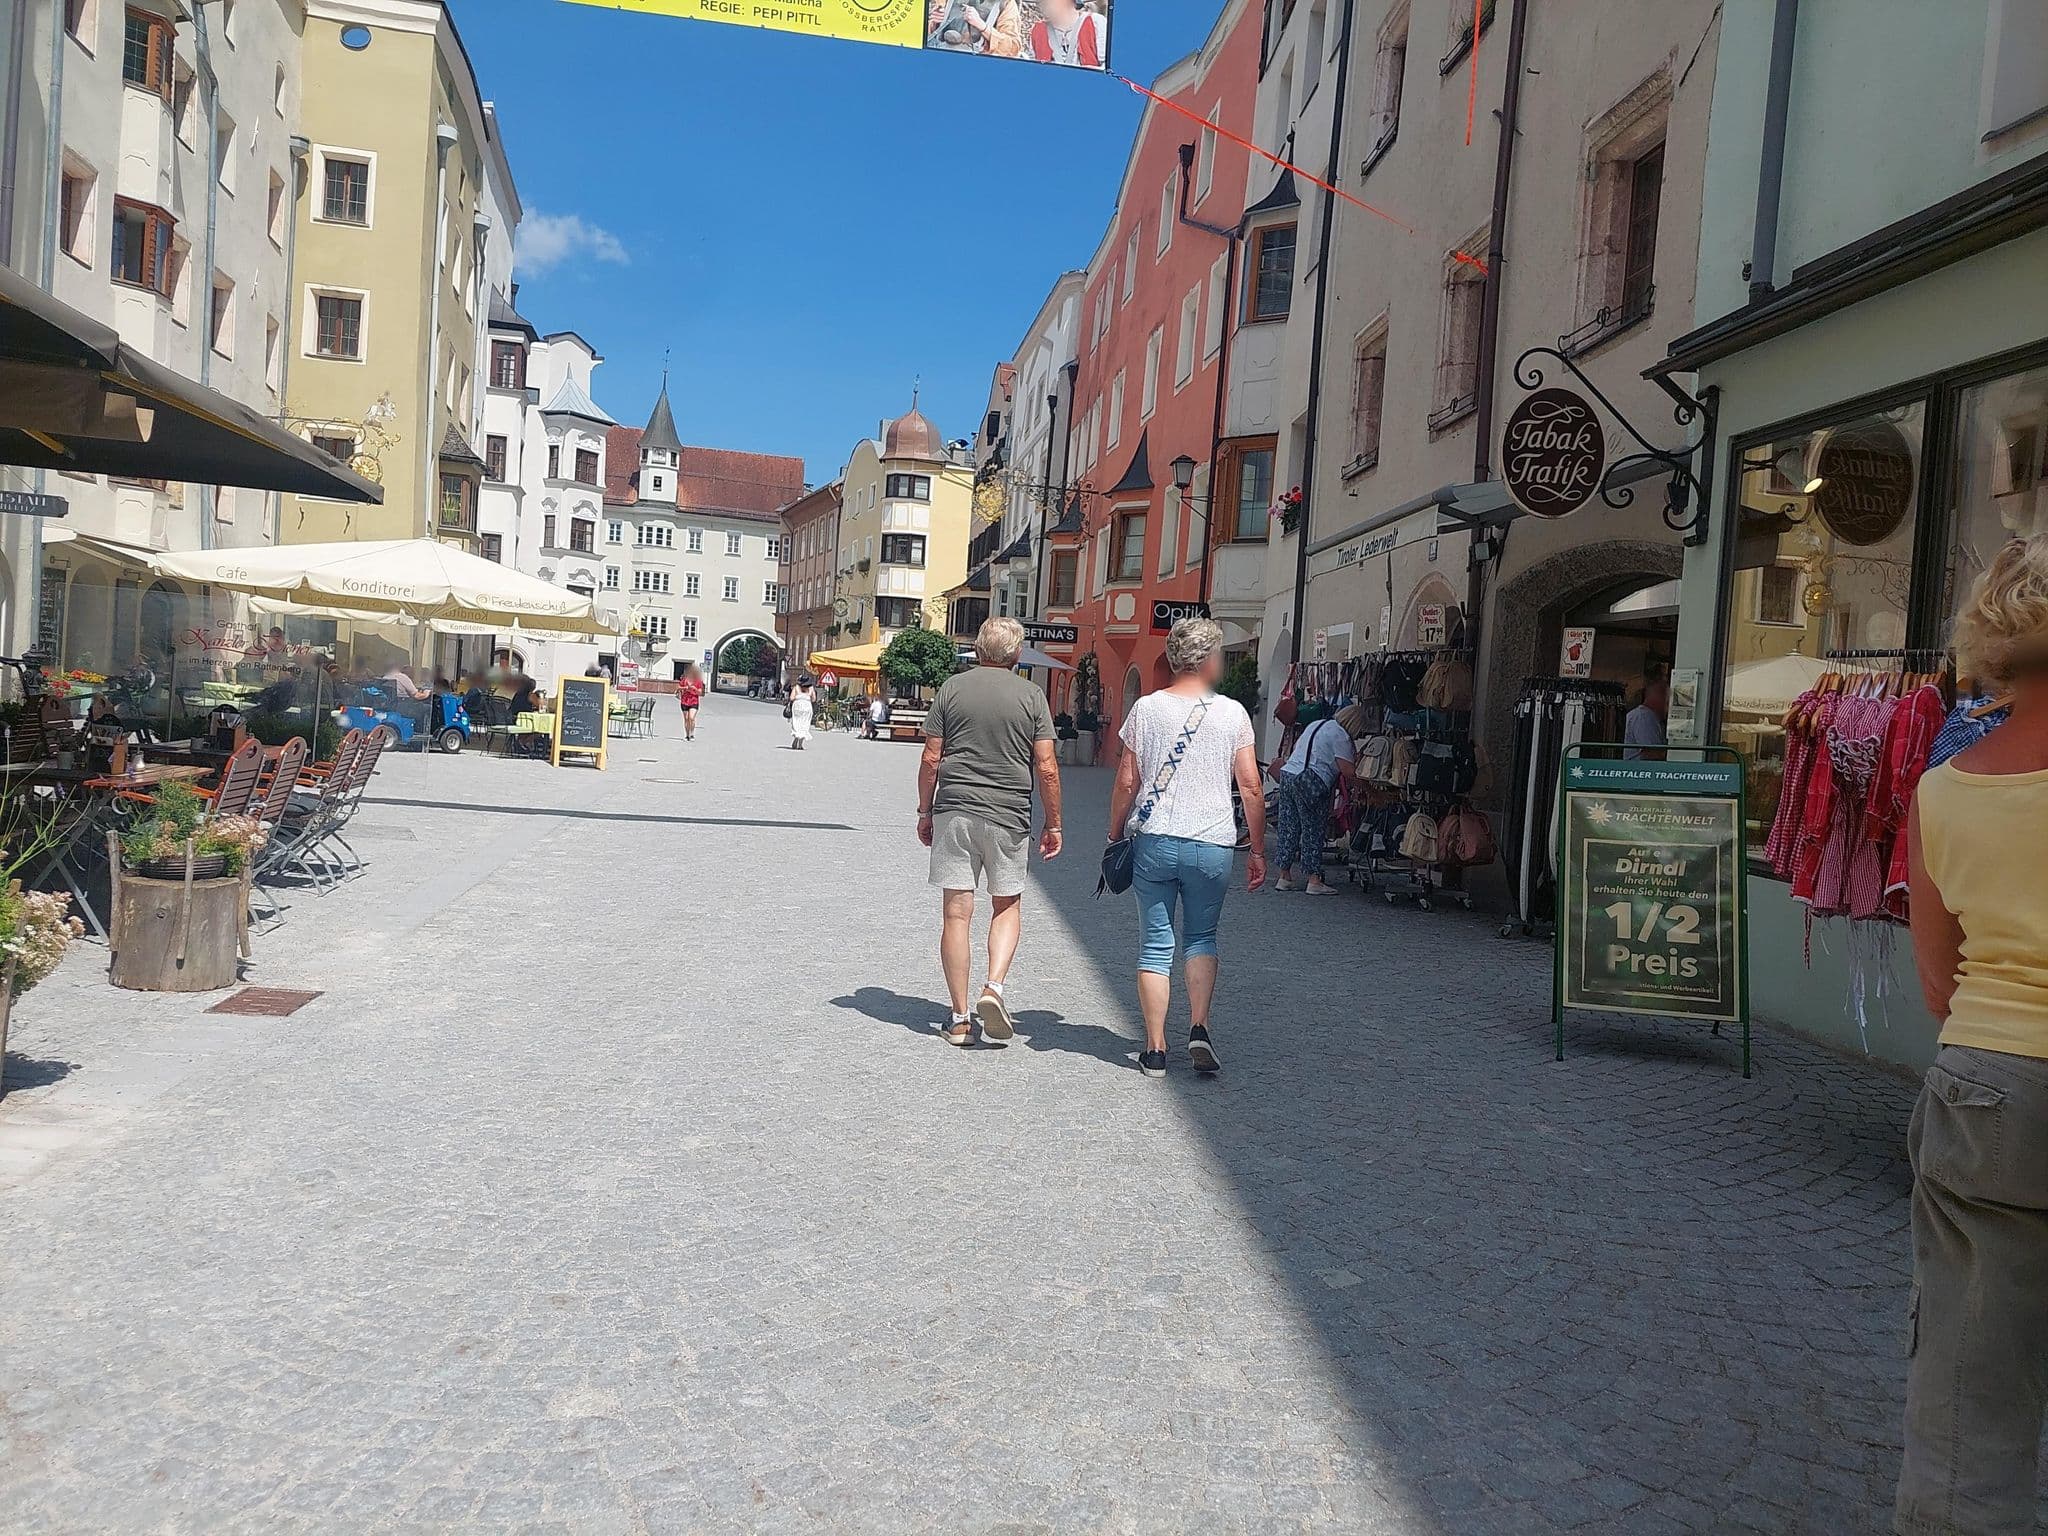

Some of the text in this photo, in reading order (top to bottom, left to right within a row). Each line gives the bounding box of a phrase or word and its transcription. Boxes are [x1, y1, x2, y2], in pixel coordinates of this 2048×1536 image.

[700, 0, 822, 26] REGIE: PEPI PITTL
[862, 0, 915, 32] RATTENBER
[1510, 416, 1598, 453] Tabak
[1509, 453, 1596, 488] Trafik
[1337, 528, 1399, 567] Tiroler Lederwelt
[215, 565, 248, 581] Cafe
[342, 577, 416, 598] Konditorei
[1153, 603, 1204, 622] Optik
[216, 619, 258, 632] Gasthof
[202, 658, 233, 668] Herzen
[1588, 769, 1731, 782] ZILLERTALER TRACHTENWELT
[1615, 812, 1716, 826] TRACHTENWELT
[1615, 857, 1688, 877] Dirndl
[1624, 876, 1678, 887] Ihrer Wahl
[1593, 886, 1709, 900] erhalten Sie heute den
[1604, 901, 1701, 945] 1/2
[1607, 944, 1699, 978] Preis
